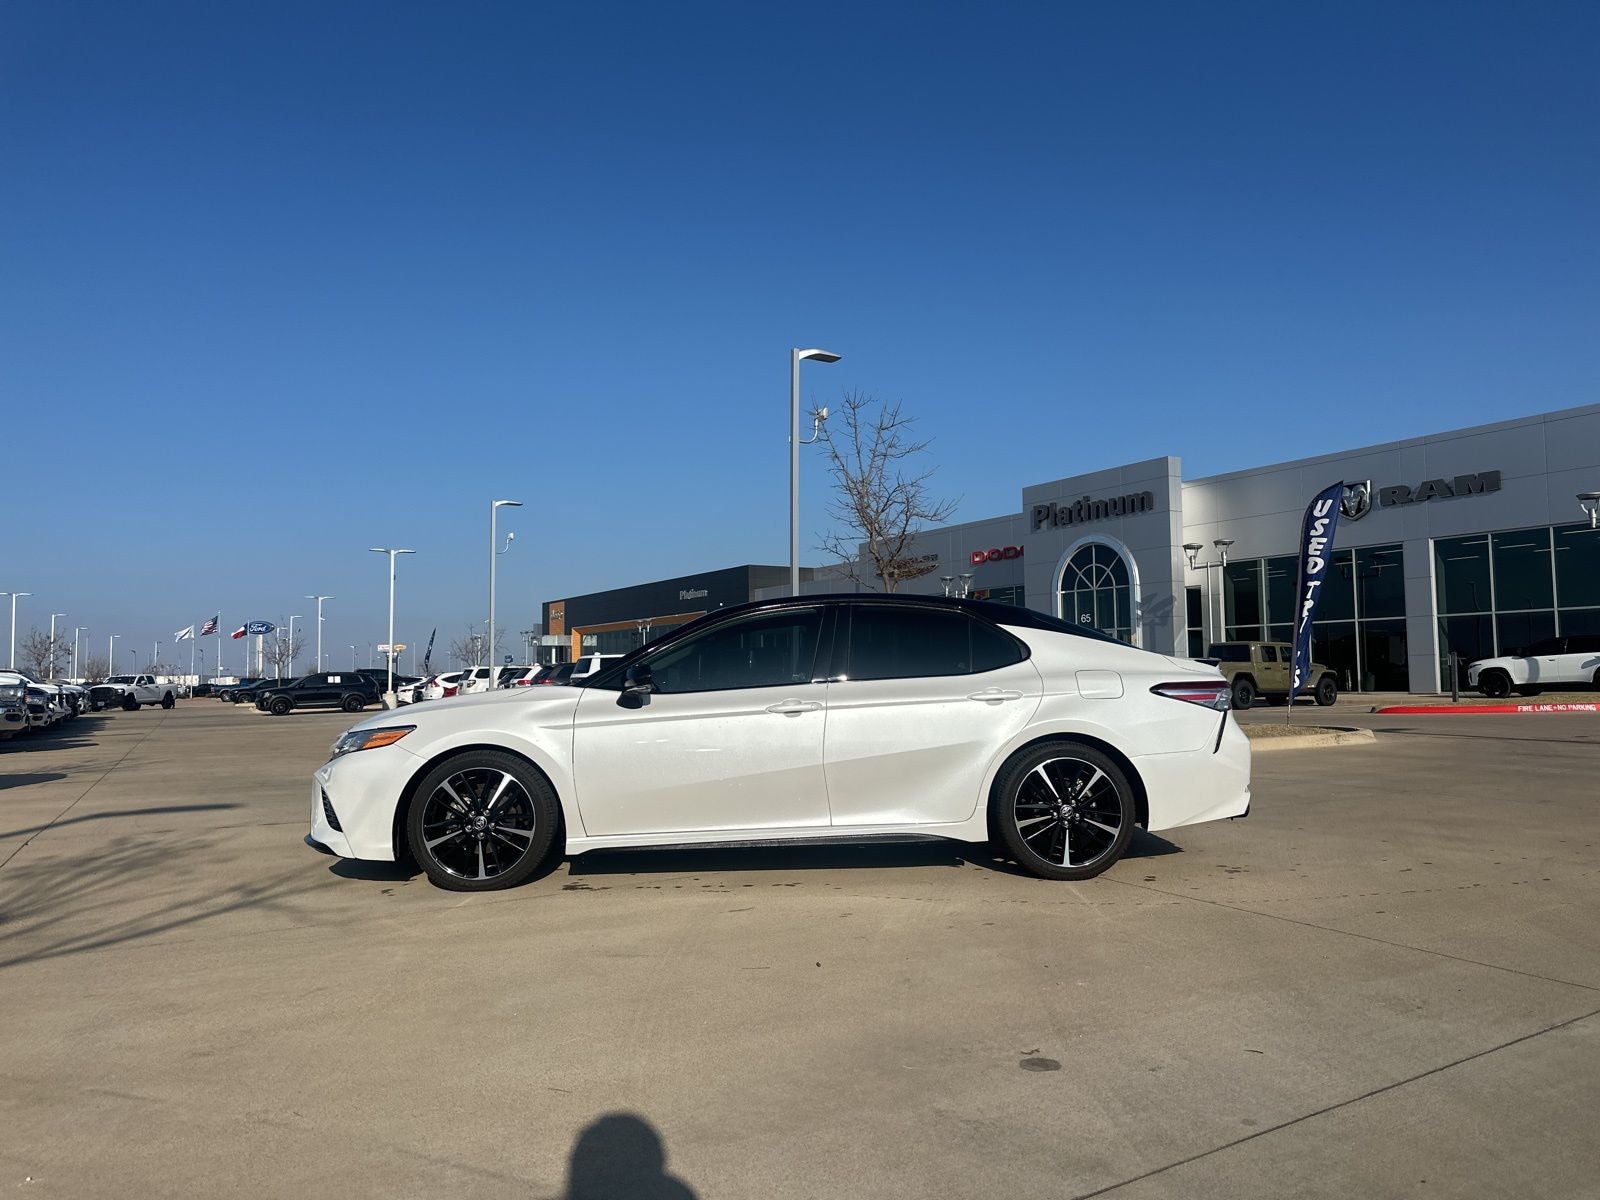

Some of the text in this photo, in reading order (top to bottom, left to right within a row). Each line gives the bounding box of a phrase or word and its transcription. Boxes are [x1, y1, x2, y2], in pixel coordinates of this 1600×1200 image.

[1379, 470, 1501, 506] RAM
[1032, 490, 1154, 530] Platinum
[1306, 499, 1333, 575] USED
[249, 623, 267, 632] Ford
[1080, 613, 1092, 623] 65
[1567, 703, 1597, 712] PARKING
